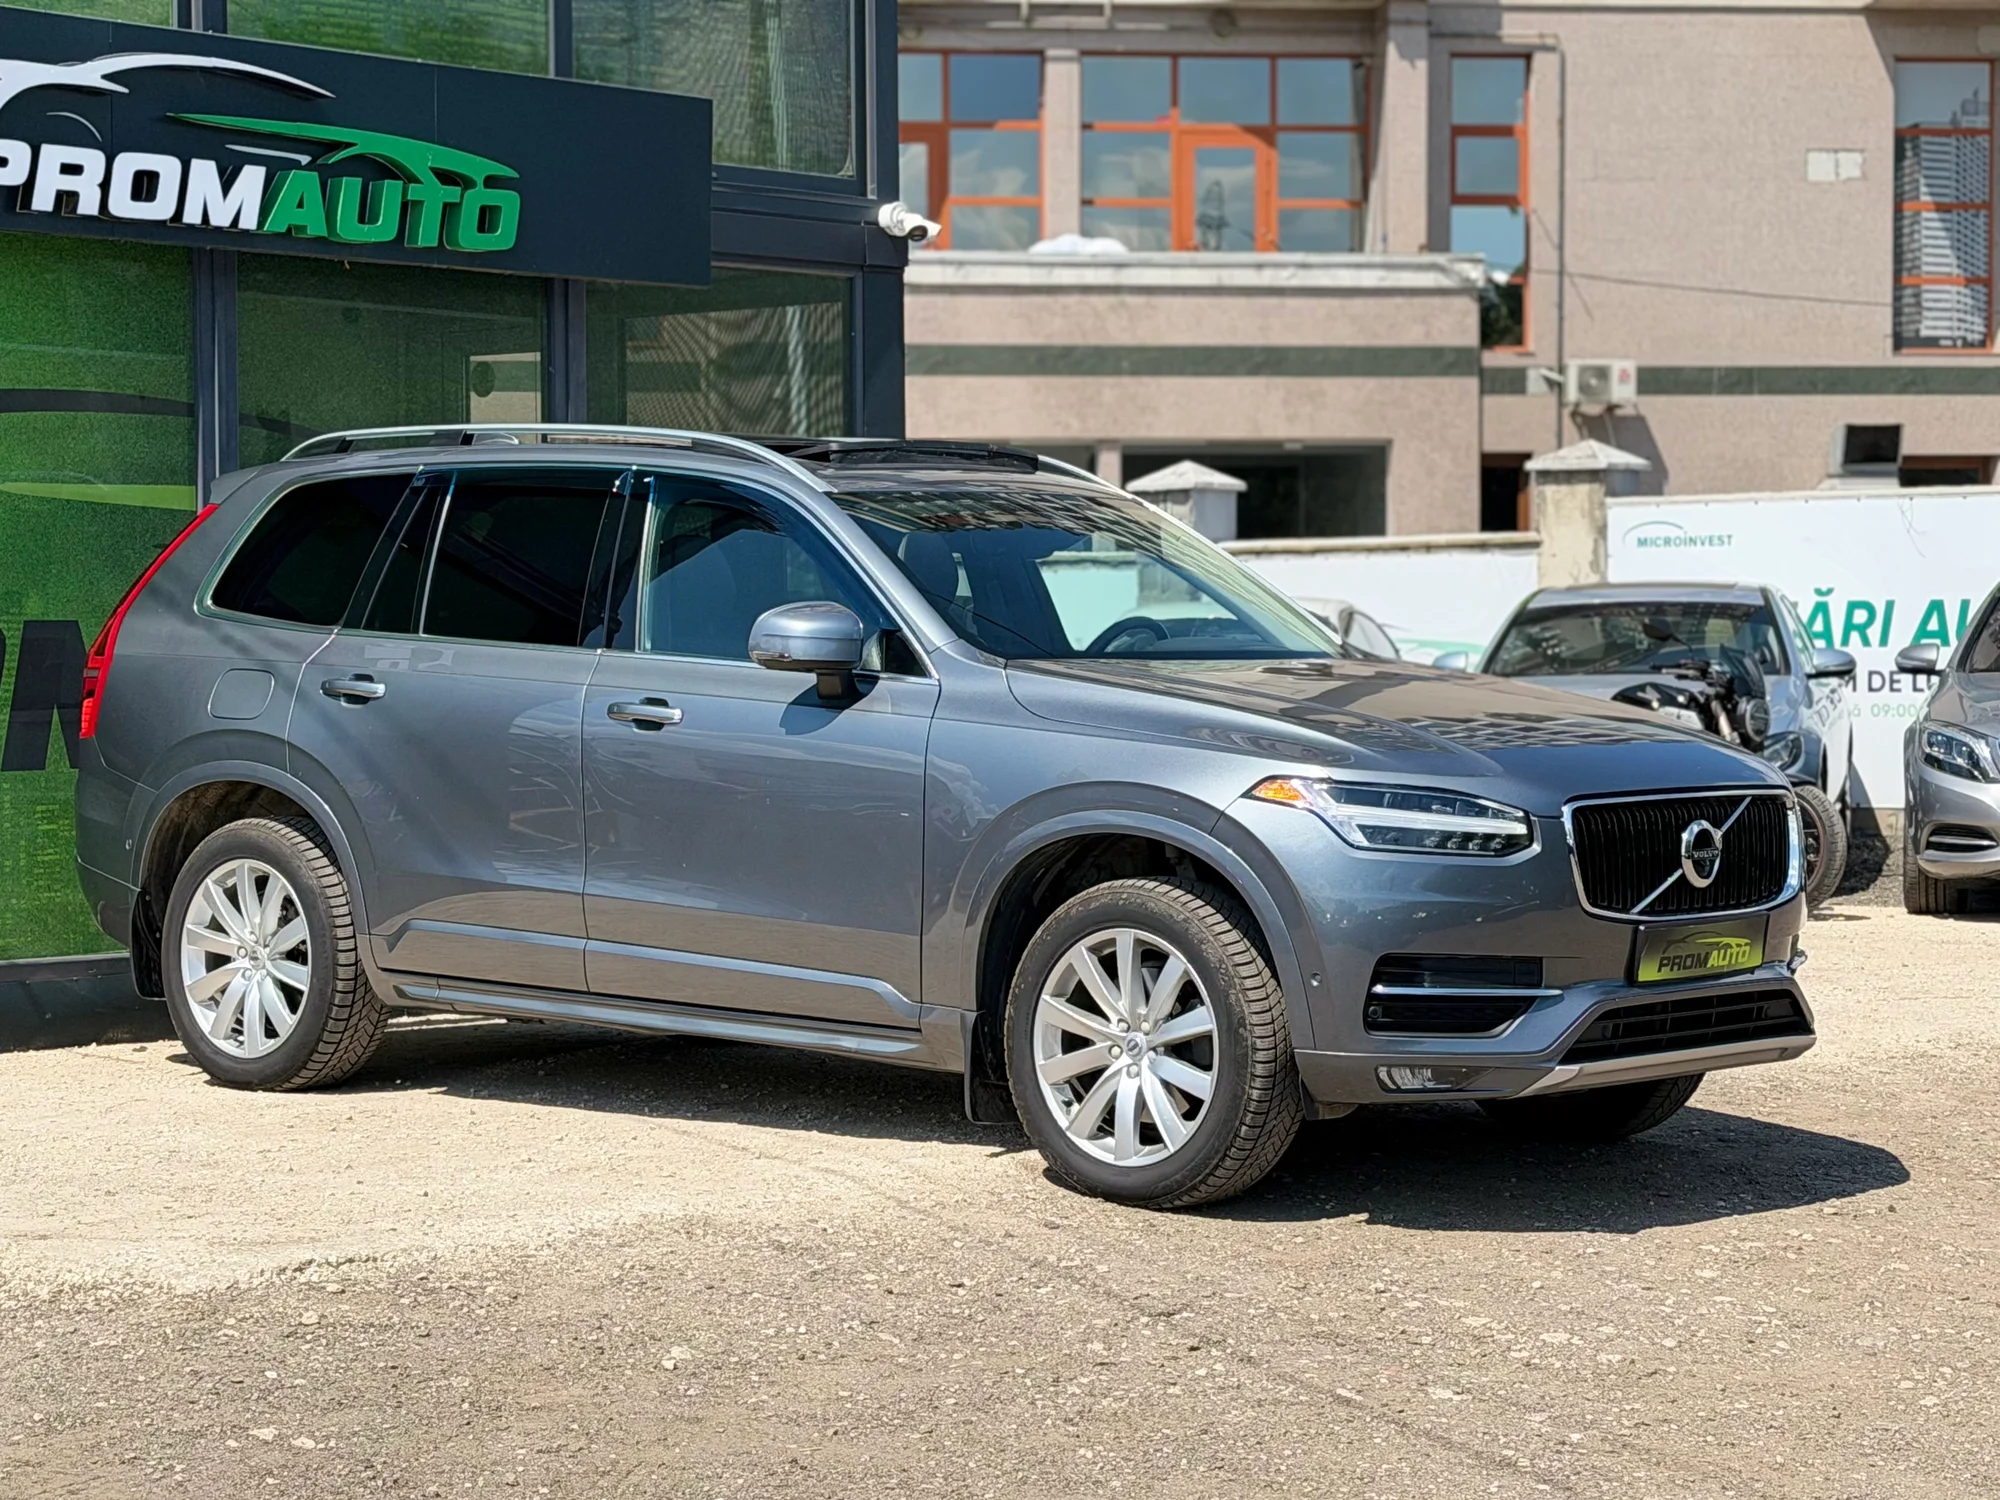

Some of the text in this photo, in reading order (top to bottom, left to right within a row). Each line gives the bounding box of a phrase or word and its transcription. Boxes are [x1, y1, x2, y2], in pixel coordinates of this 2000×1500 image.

[1794, 587, 1896, 649] ĂRI
[1868, 670, 1902, 693] DE
[1692, 849, 1719, 859] VOLVO
[1657, 945, 1751, 974] PROMAUTO
